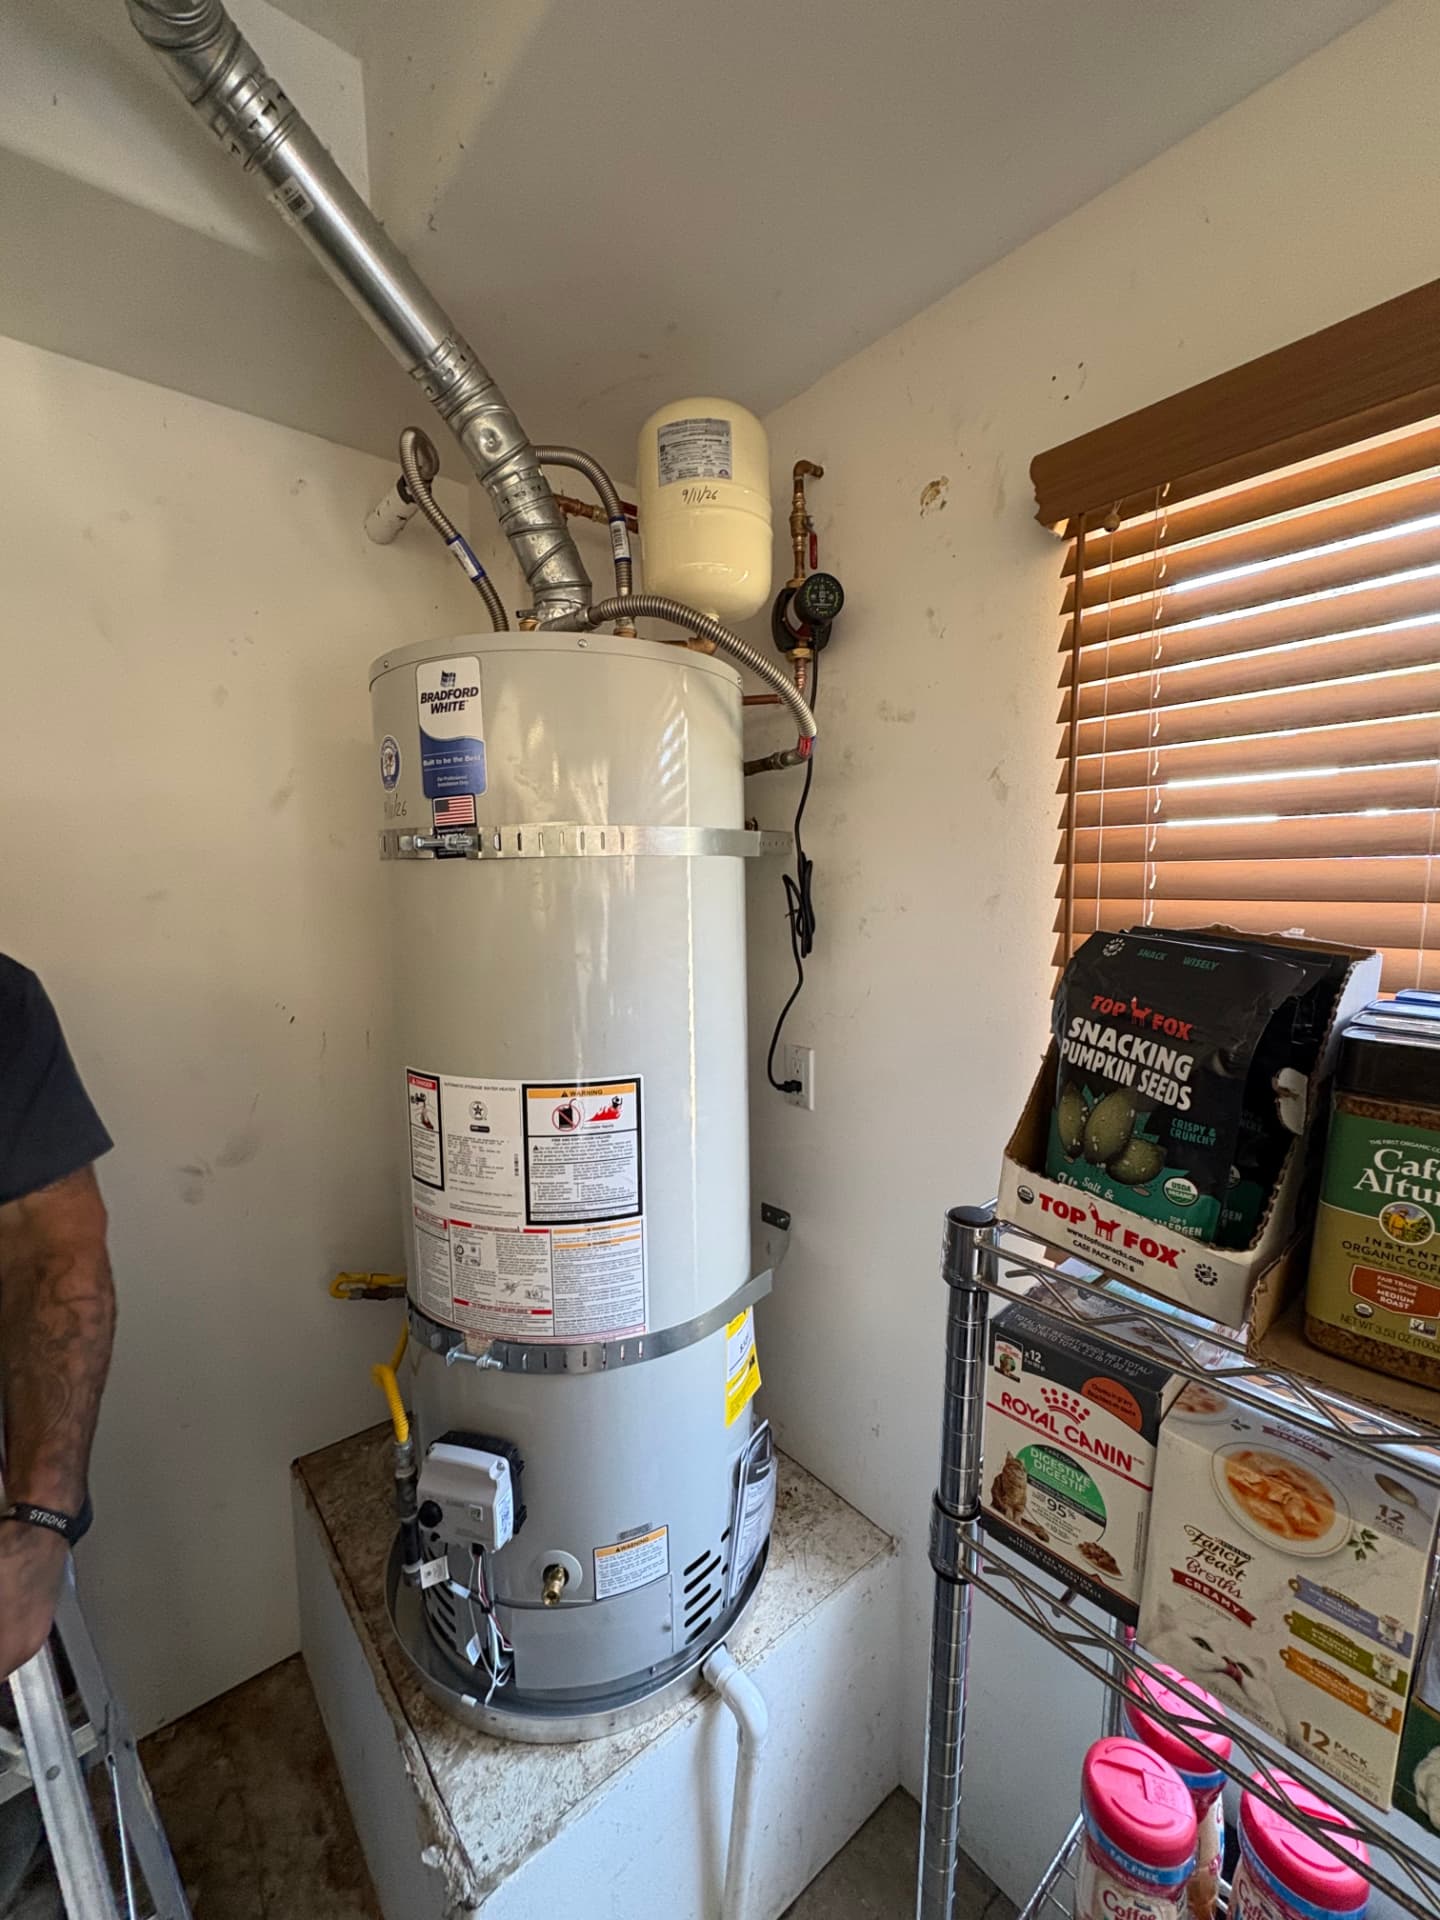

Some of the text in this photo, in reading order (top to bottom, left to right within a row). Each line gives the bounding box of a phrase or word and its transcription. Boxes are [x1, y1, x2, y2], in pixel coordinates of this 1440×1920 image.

[682, 485, 718, 504] 9/11/26
[420, 686, 479, 704] BRADFORD
[431, 701, 466, 714] WHITE
[1137, 948, 1168, 960] SNACK
[1090, 995, 1193, 1040] TOP FOX
[1067, 1016, 1194, 1082] SNACKING
[1061, 1038, 1193, 1111] PUMPKIN SEEDS
[570, 1089, 603, 1097] WARNING
[1170, 1127, 1216, 1146] CRUNCHY
[1171, 1118, 1216, 1137] CRISPY &
[1082, 1176, 1102, 1194] Salt
[1171, 1181, 1191, 1192] USDA
[1038, 1192, 1182, 1269] TOP FOX
[1153, 1218, 1202, 1236] ERGEN
[1073, 1239, 1090, 1252] CASE
[1092, 1247, 1111, 1261] PACK
[1342, 1240, 1440, 1274] ORGANIC COF
[1365, 1236, 1440, 1261] INSTANT
[1376, 1289, 1415, 1304] MEDIUM
[1380, 1296, 1410, 1309] ROAST
[1000, 1391, 1059, 1435] ROYAL
[1064, 1424, 1133, 1472] CANIN
[1030, 1447, 1091, 1489] DIGESTIVE
[1033, 1459, 1087, 1493] DIGESTIF
[30, 1509, 68, 1529] STRONG
[1379, 1504, 1405, 1526] 12
[621, 1536, 650, 1552] WARNING
[1184, 1525, 1251, 1568] Fancy
[1192, 1543, 1247, 1582] Feast
[1186, 1557, 1243, 1599] Broths
[1185, 1578, 1241, 1613] CREAMY
[1300, 1720, 1368, 1769] 12 PACK
